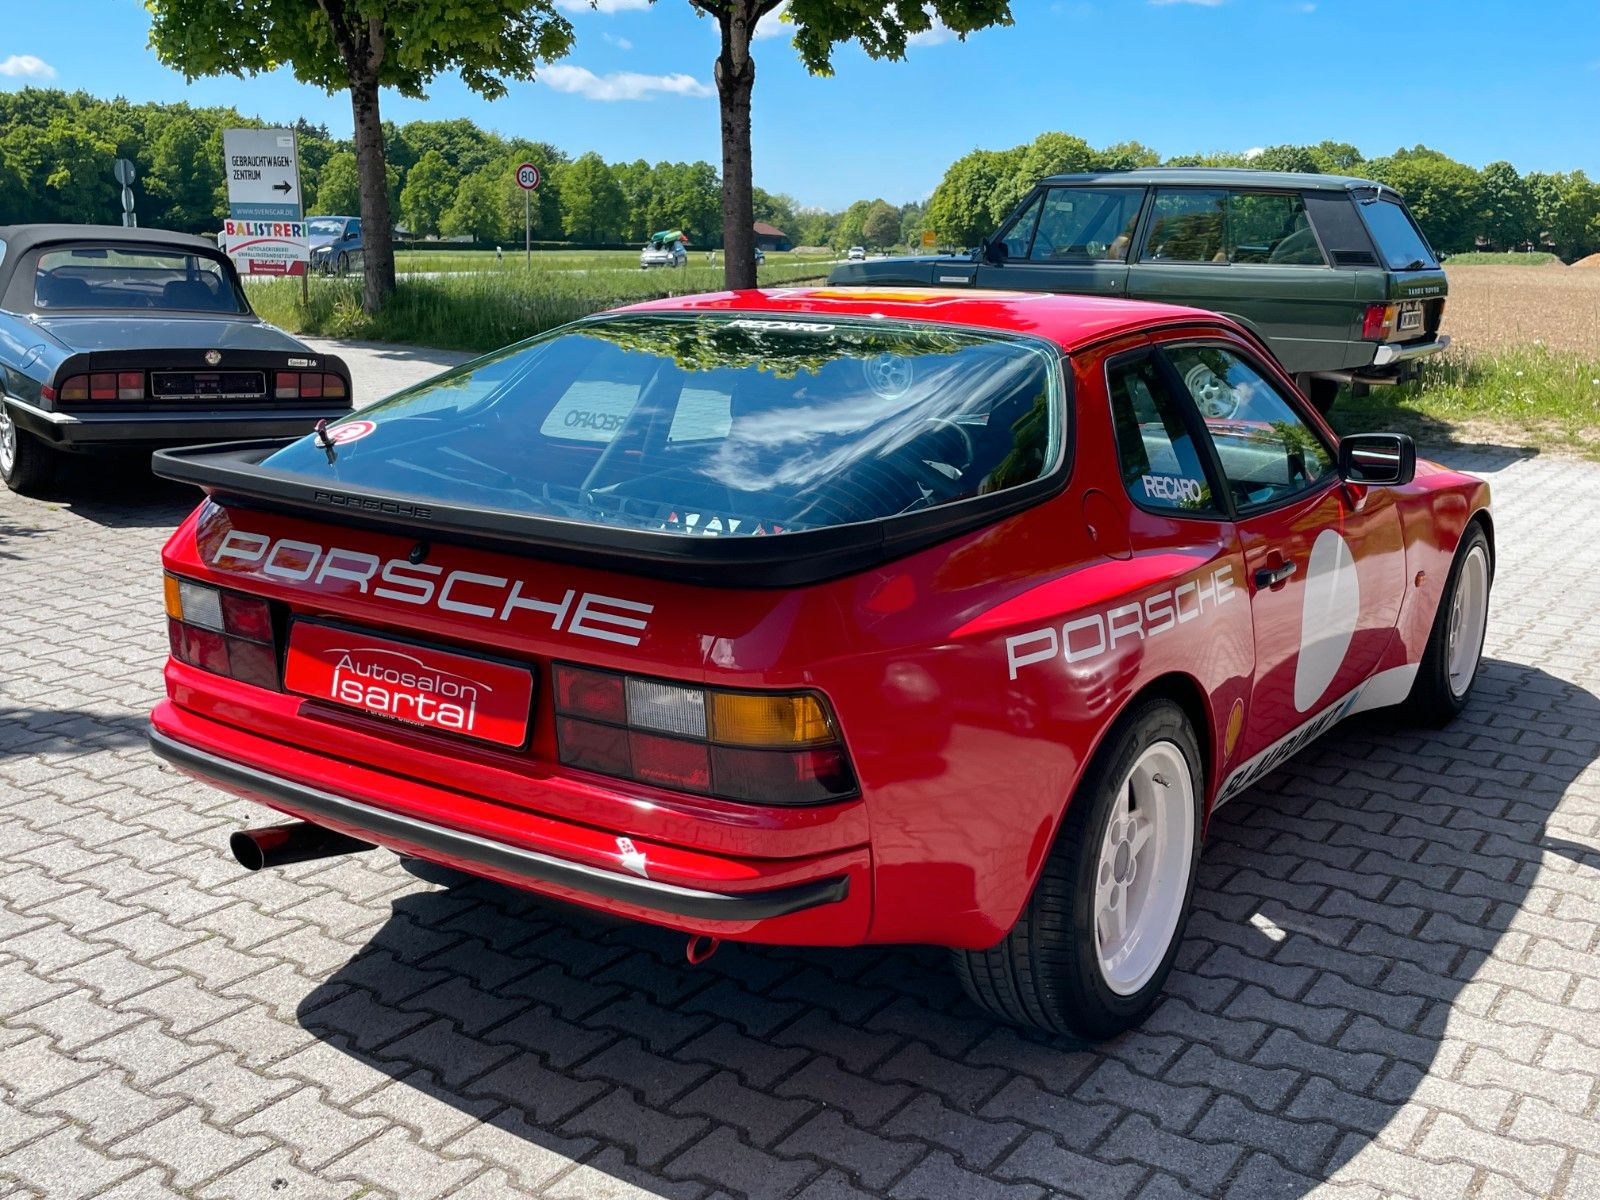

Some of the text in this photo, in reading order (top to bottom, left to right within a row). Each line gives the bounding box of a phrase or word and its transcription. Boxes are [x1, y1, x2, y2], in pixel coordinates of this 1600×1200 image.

[232, 155, 292, 167] GEBRAUCHTWAGEN-
[233, 169, 261, 180] ZENTRUM
[521, 170, 535, 183] 80
[226, 222, 307, 238] BALISTRERI
[1141, 474, 1202, 502] RECARO
[314, 491, 432, 520] PORSCHE
[212, 530, 655, 647] PORSCHE
[1006, 564, 1236, 680] PORSCHE
[335, 654, 478, 701] Autosalon
[331, 668, 476, 731] Isartal
